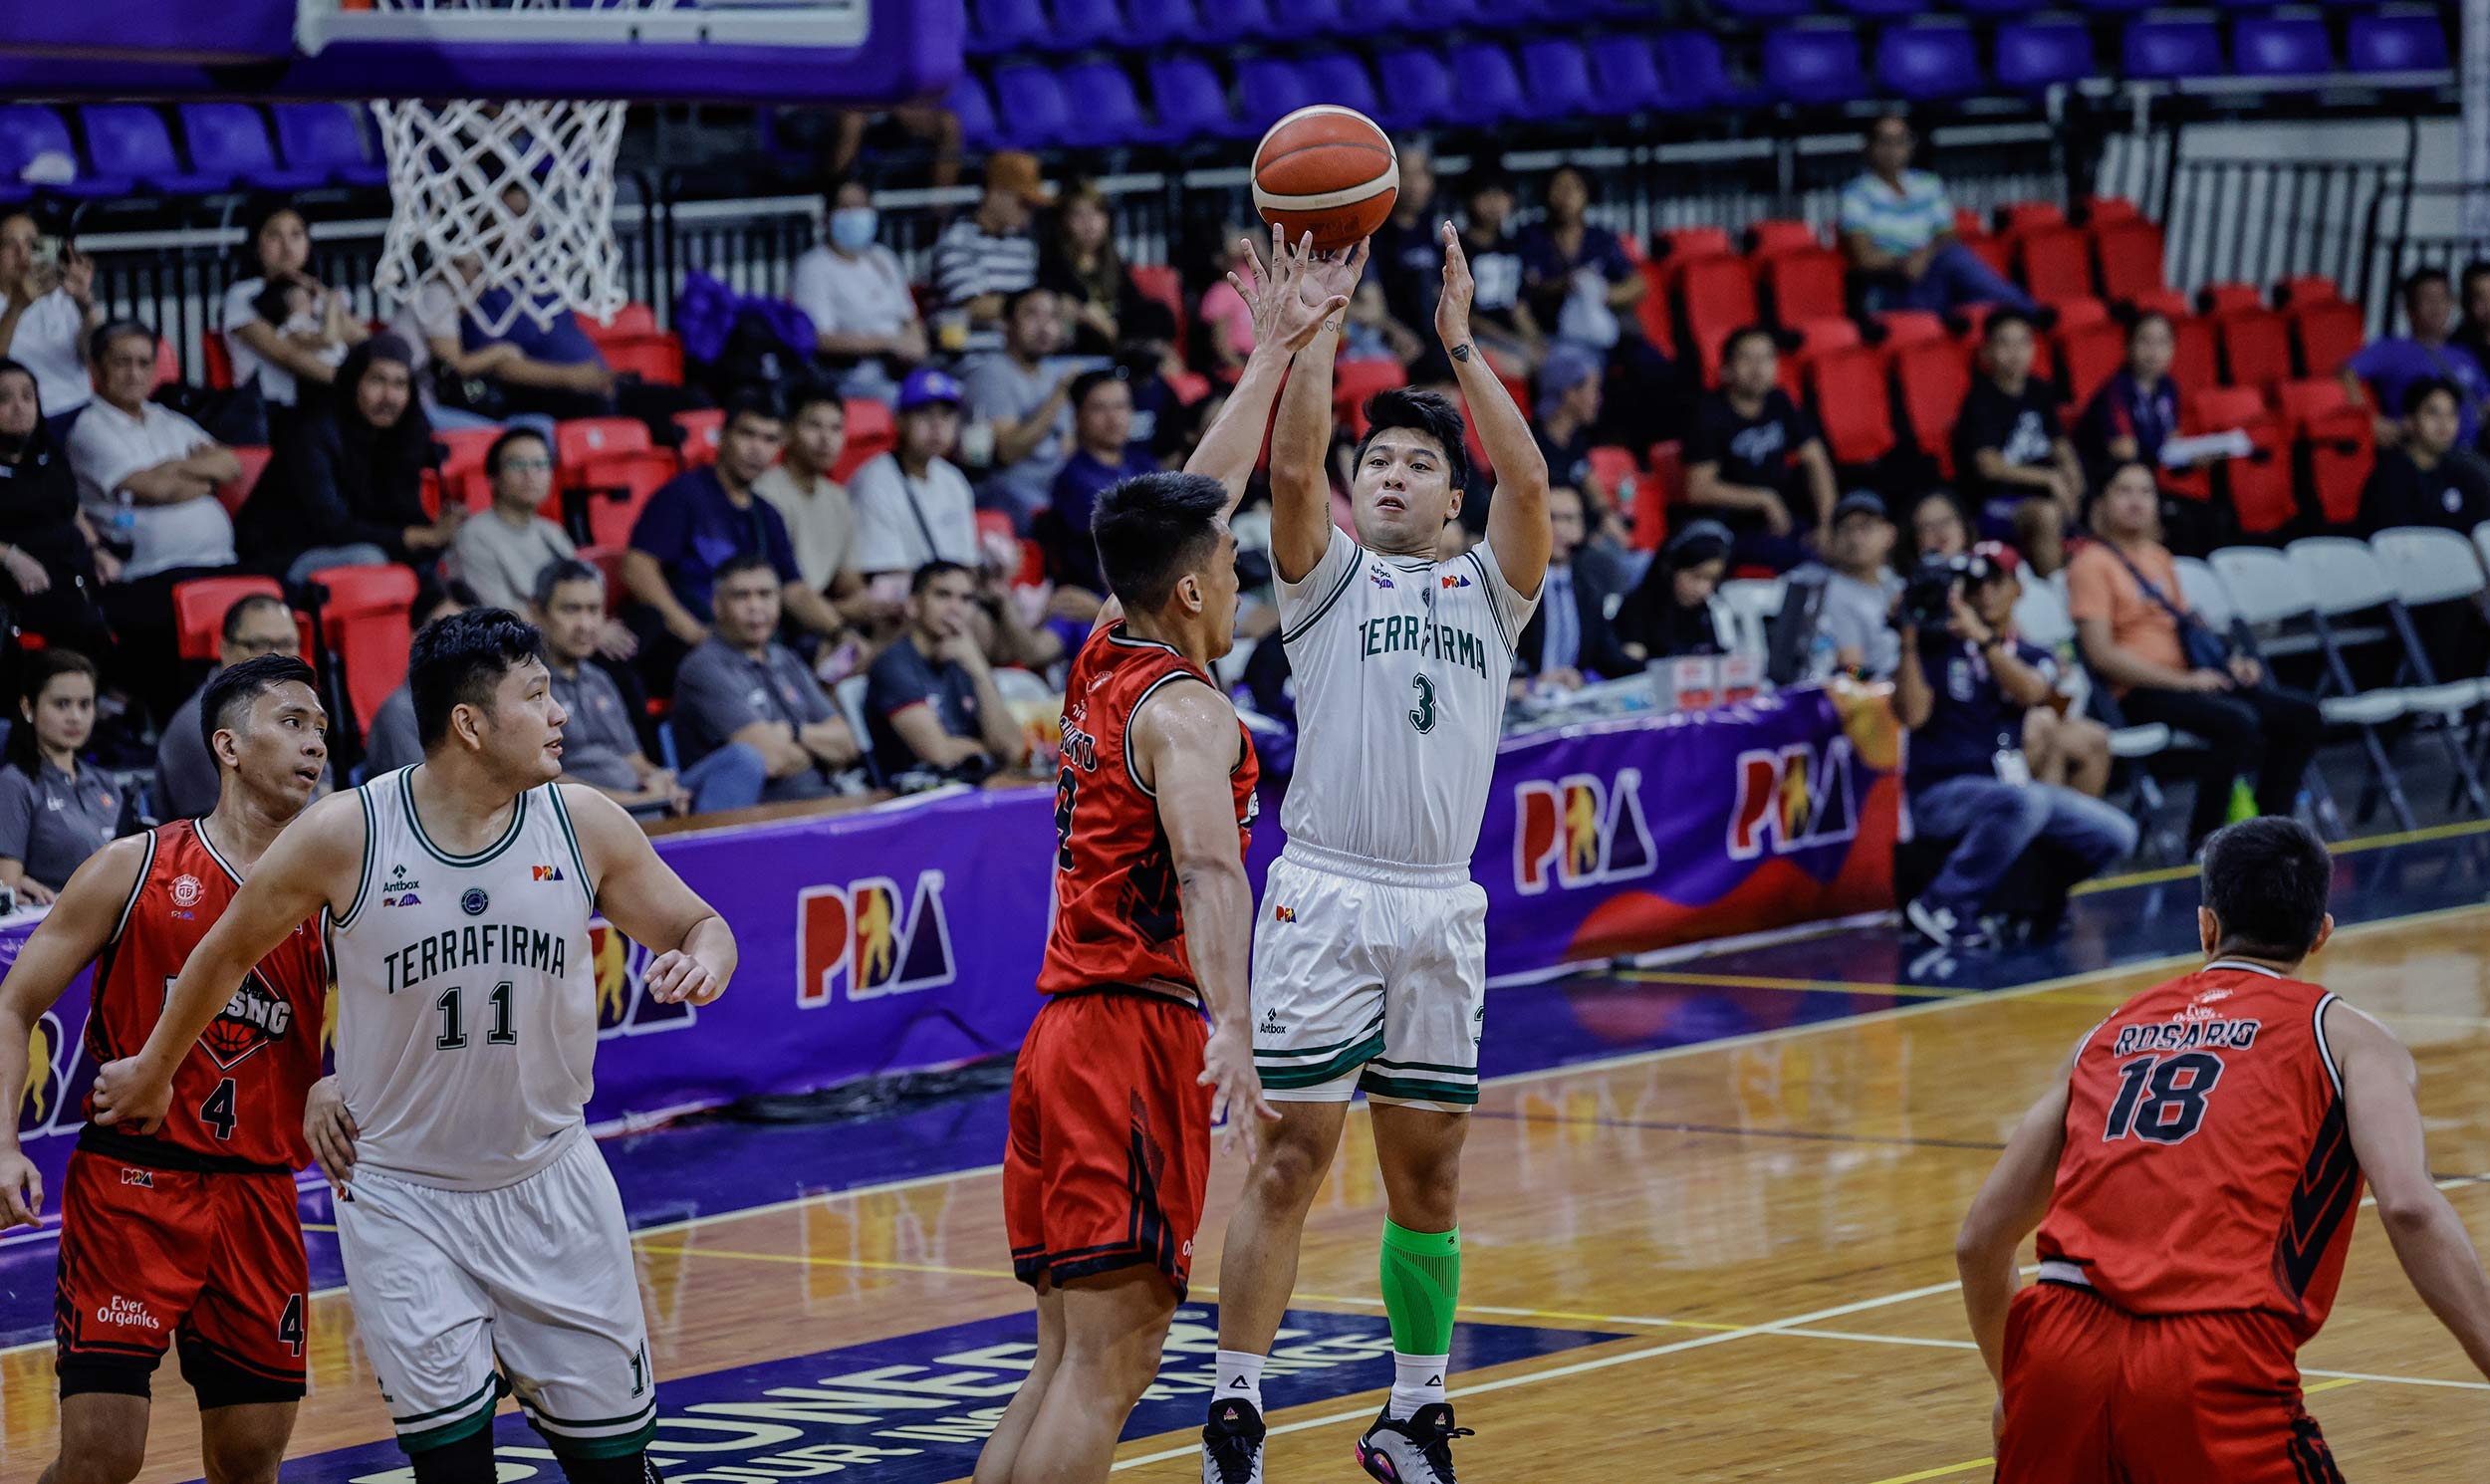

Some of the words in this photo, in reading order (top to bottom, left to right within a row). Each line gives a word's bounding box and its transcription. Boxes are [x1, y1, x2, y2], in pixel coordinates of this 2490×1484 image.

[1441, 574, 1471, 590] PBA
[1408, 672, 1436, 734] 3
[1727, 736, 1858, 861] PBA
[1513, 768, 1658, 895] PBA
[382, 880, 420, 892] Antbox
[532, 866, 565, 881] PBA
[383, 924, 566, 994] TERRAFIRMA
[796, 868, 957, 1010] PBA
[436, 981, 517, 1051] 11
[2114, 1018, 2262, 1059] ROSARIO
[200, 1078, 236, 1140] 4
[2103, 1050, 2225, 1145] 18
[121, 1167, 154, 1188] PBA
[97, 1307, 159, 1330] Organics
[112, 1296, 142, 1313] Ever
[278, 1293, 304, 1358] 4
